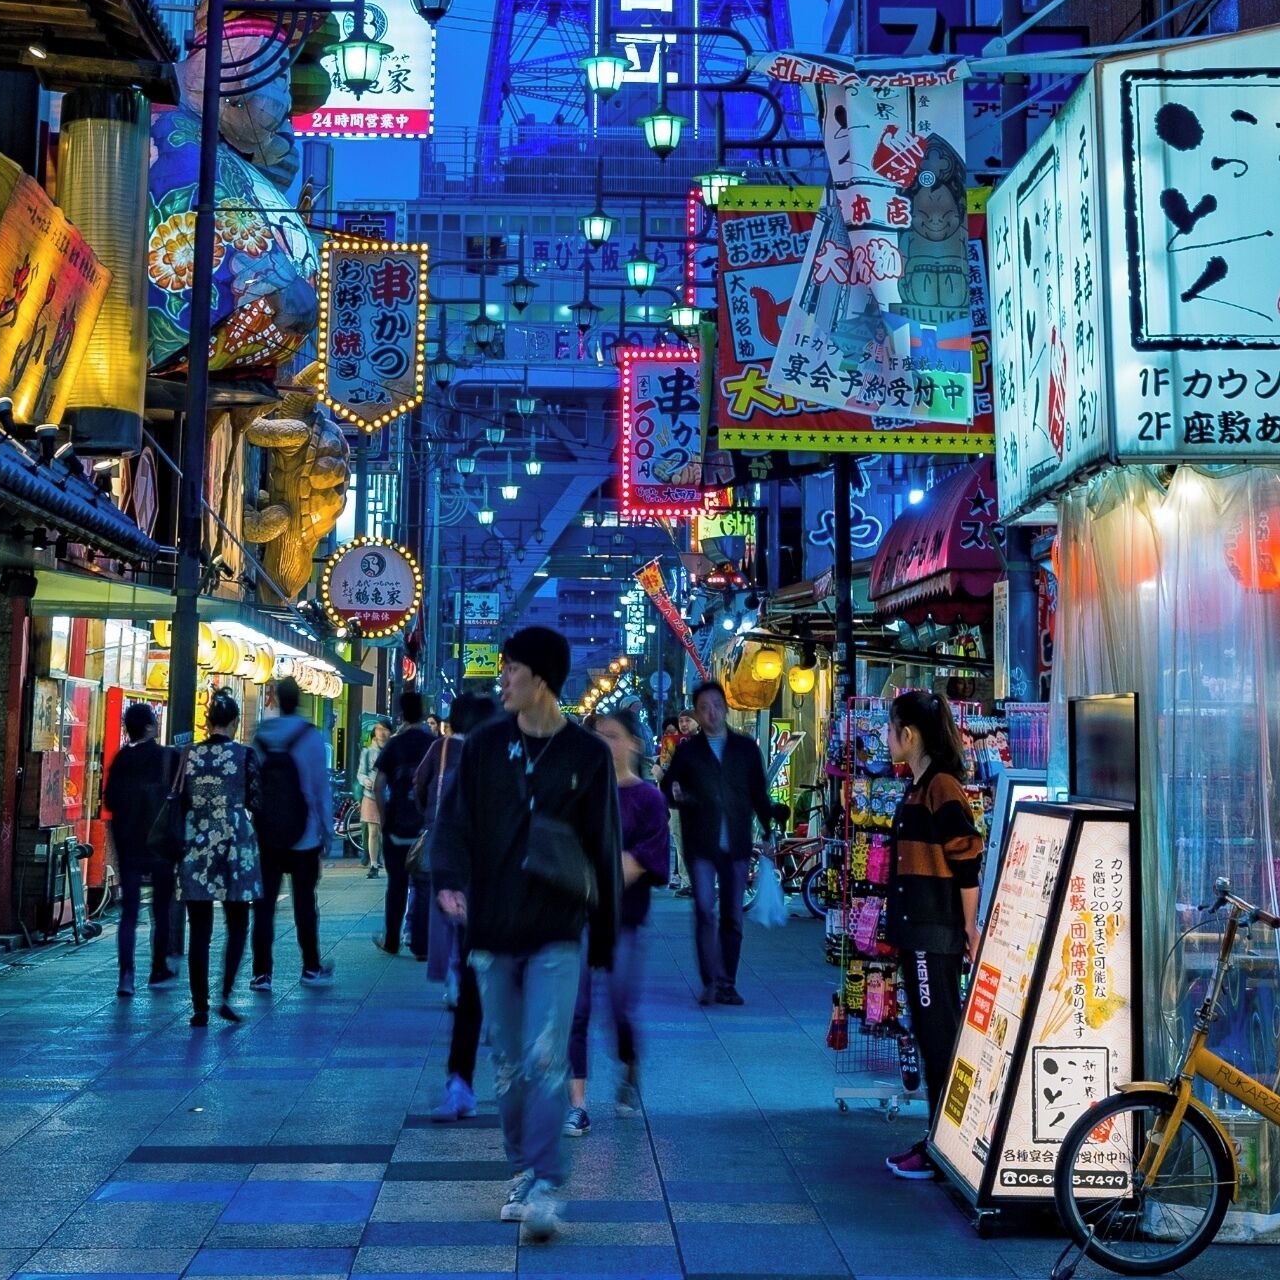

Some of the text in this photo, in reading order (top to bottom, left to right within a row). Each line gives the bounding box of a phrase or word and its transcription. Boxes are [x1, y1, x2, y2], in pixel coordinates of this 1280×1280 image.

[311, 112, 410, 130] 24時間営業中
[972, 101, 1064, 118] アサビール
[723, 214, 791, 246] 新世界
[333, 261, 365, 379] お好み焼き
[370, 260, 414, 376] 串かつ
[729, 274, 756, 358] 大阪名物
[1139, 367, 1170, 400] 1F
[656, 366, 701, 474] 串かつ
[1138, 412, 1171, 443] 2F
[916, 958, 931, 1008] KENZO
[1003, 1148, 1127, 1166] 各種宴会受付中!!
[1017, 1167, 1124, 1187] 06-65-9499
